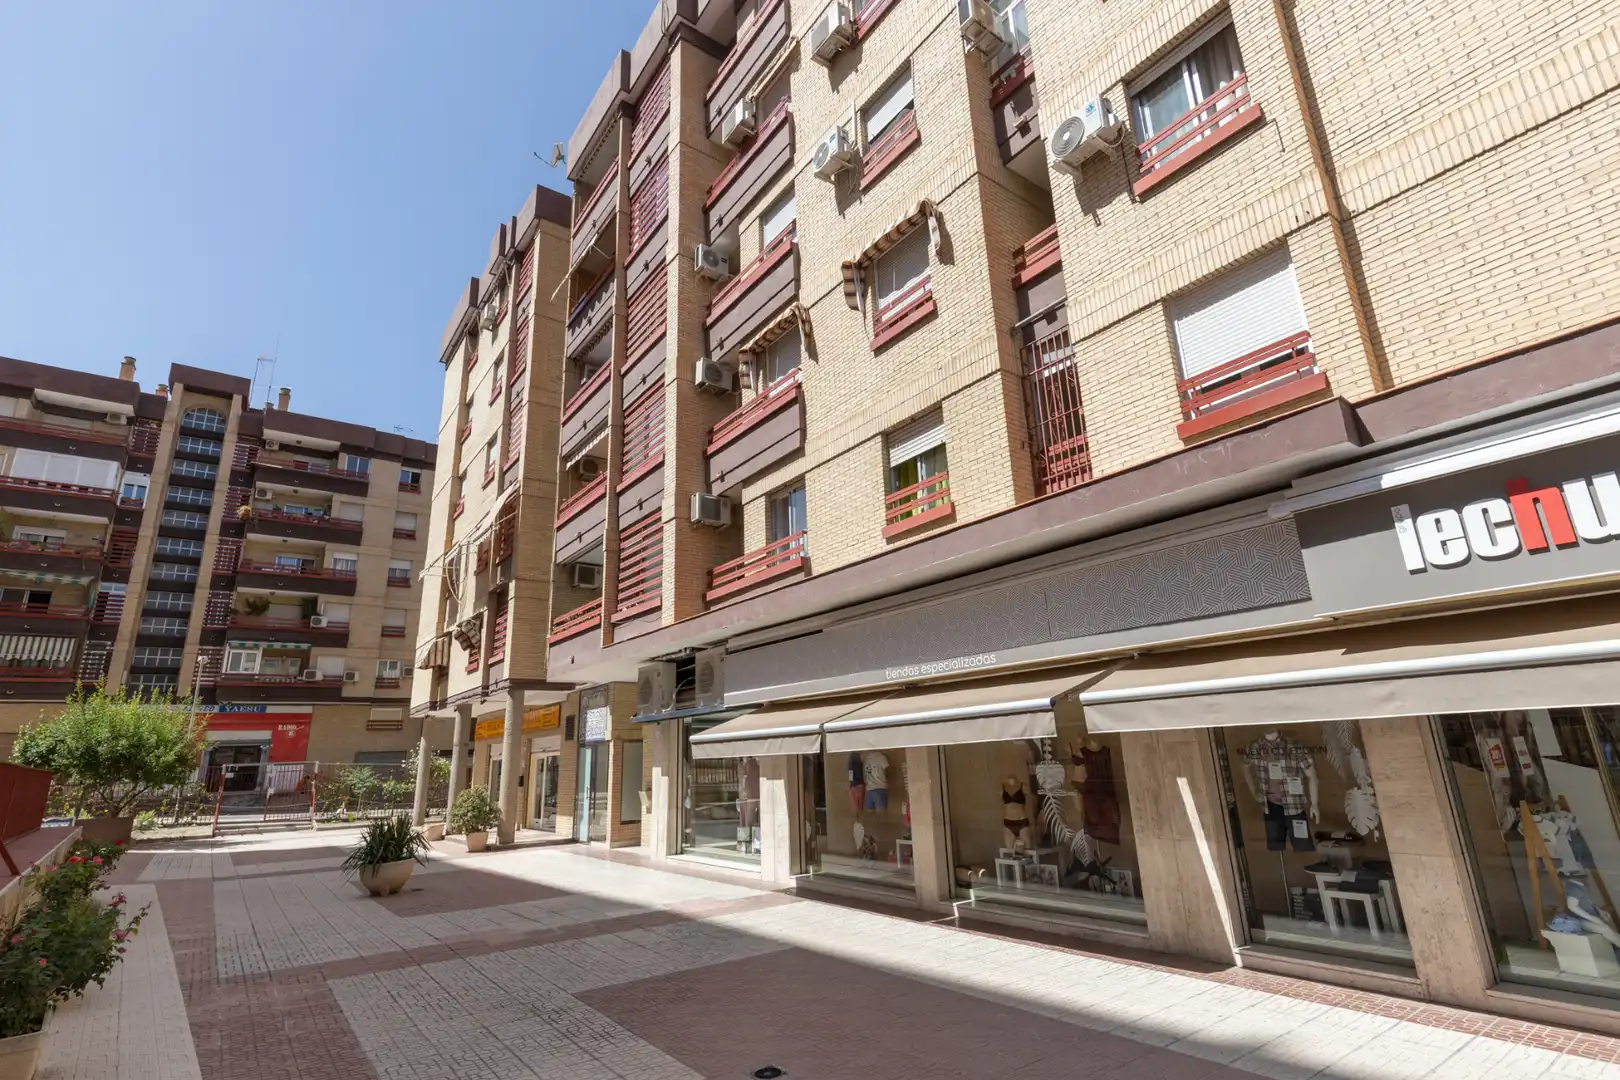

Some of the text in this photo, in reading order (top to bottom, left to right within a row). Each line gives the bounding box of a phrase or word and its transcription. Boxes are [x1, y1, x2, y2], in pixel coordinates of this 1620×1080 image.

[885, 654, 997, 680] tiendas especializadas
[224, 704, 261, 713] YAESU
